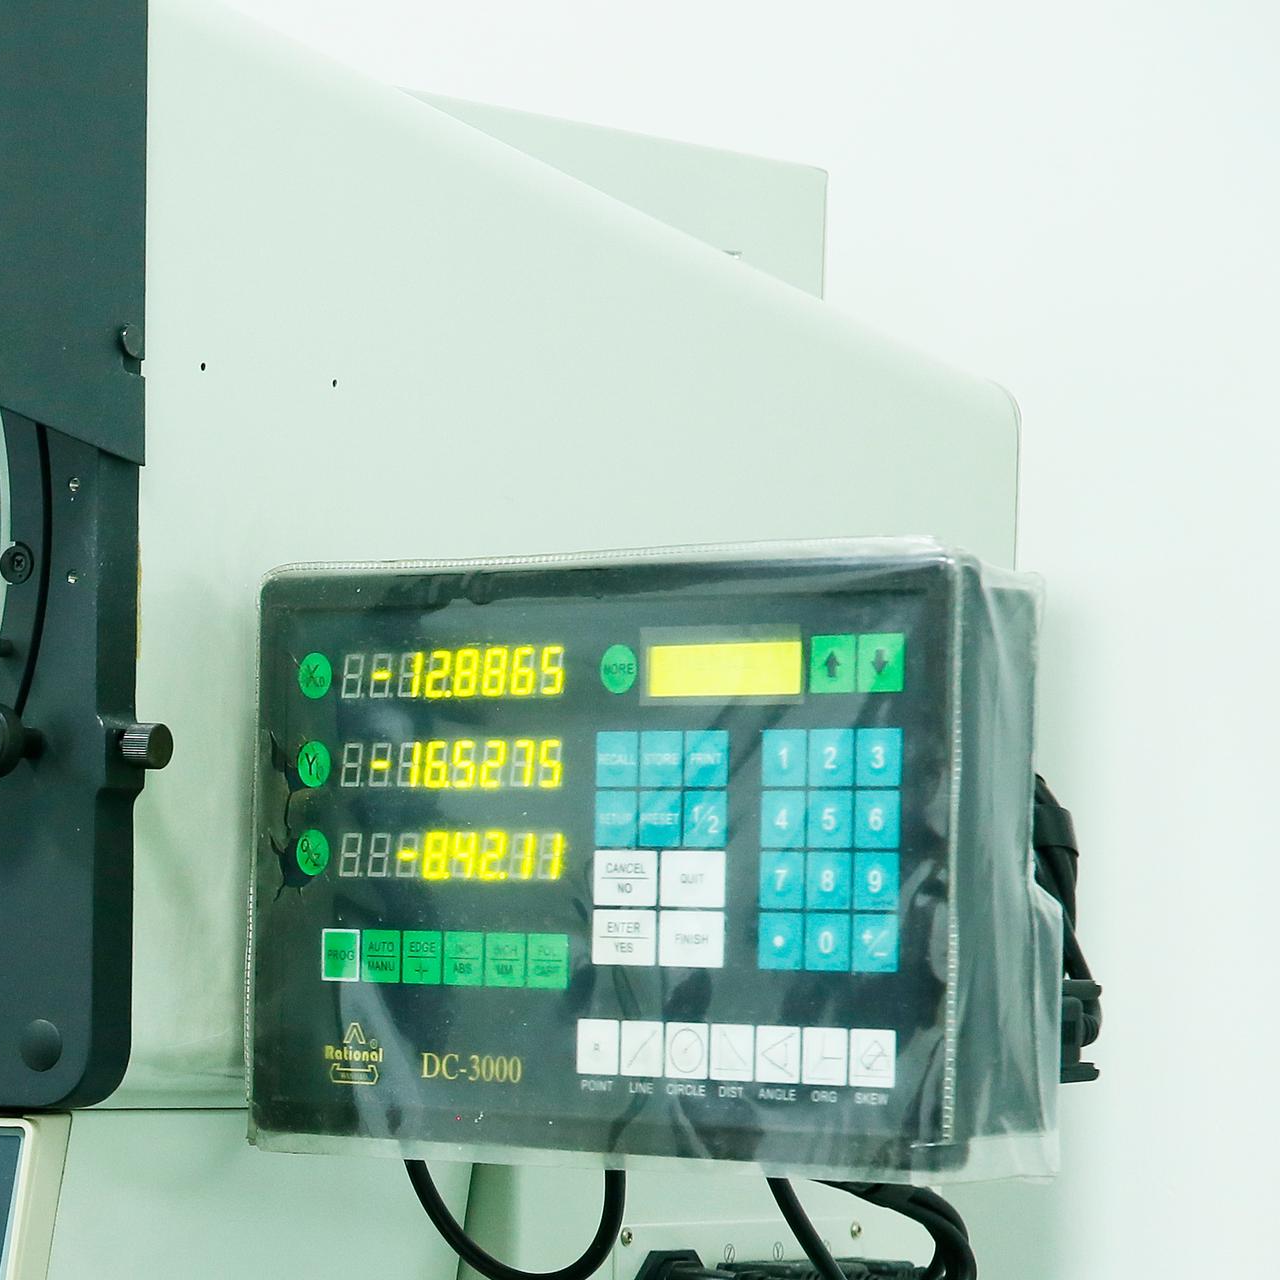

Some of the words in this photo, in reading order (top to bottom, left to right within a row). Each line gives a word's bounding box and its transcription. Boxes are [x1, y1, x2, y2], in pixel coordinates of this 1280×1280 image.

[778, 747, 789, 769] 1
[824, 746, 837, 769] 2
[871, 746, 886, 769] 3
[774, 808, 789, 830] 4
[822, 808, 837, 831] 5
[868, 807, 884, 831] 6
[605, 862, 647, 875] CANCEL
[679, 873, 705, 885] QUIT
[775, 869, 788, 891] 7
[820, 869, 835, 892] 8
[867, 869, 883, 893] 9
[616, 883, 633, 894] NO
[607, 922, 641, 934] ENTER
[367, 941, 395, 952] AUTO
[409, 941, 436, 953] EDGE
[614, 942, 634, 953] YES
[818, 930, 835, 954] 0
[326, 949, 356, 961] PROG
[366, 960, 396, 972] MANU
[324, 1044, 384, 1063] Rational
[420, 1052, 523, 1084] DC-3000
[580, 1079, 614, 1094] POINT
[628, 1082, 654, 1095] LINE
[666, 1083, 707, 1098] CIRCLE
[717, 1085, 745, 1099] DIST
[758, 1088, 797, 1102] ANGLE
[811, 1090, 838, 1104] ORG
[854, 1092, 889, 1106] SKEW
